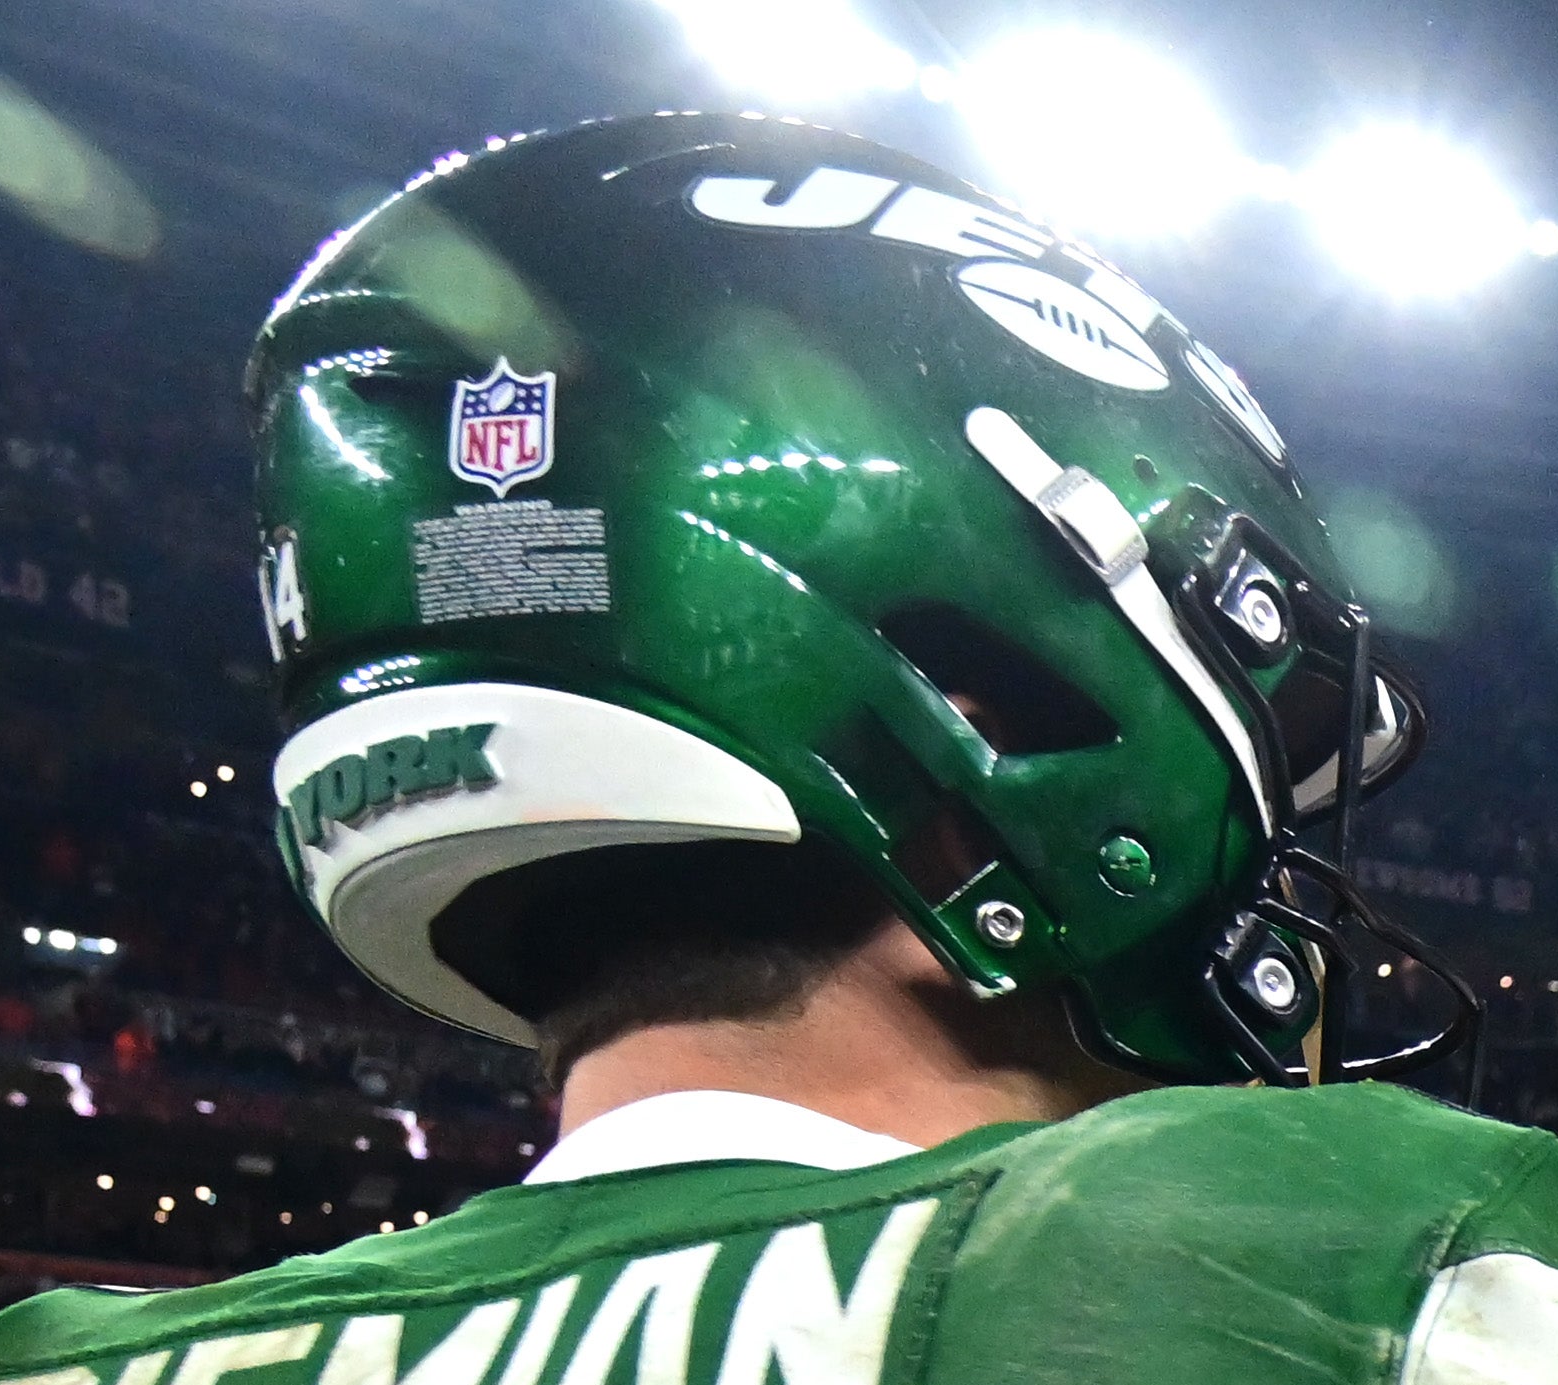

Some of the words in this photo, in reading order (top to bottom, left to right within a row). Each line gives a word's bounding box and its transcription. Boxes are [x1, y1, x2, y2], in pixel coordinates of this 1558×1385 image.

[462, 416, 538, 471] NFL
[70, 571, 131, 627] 42
[287, 722, 504, 850] YORK
